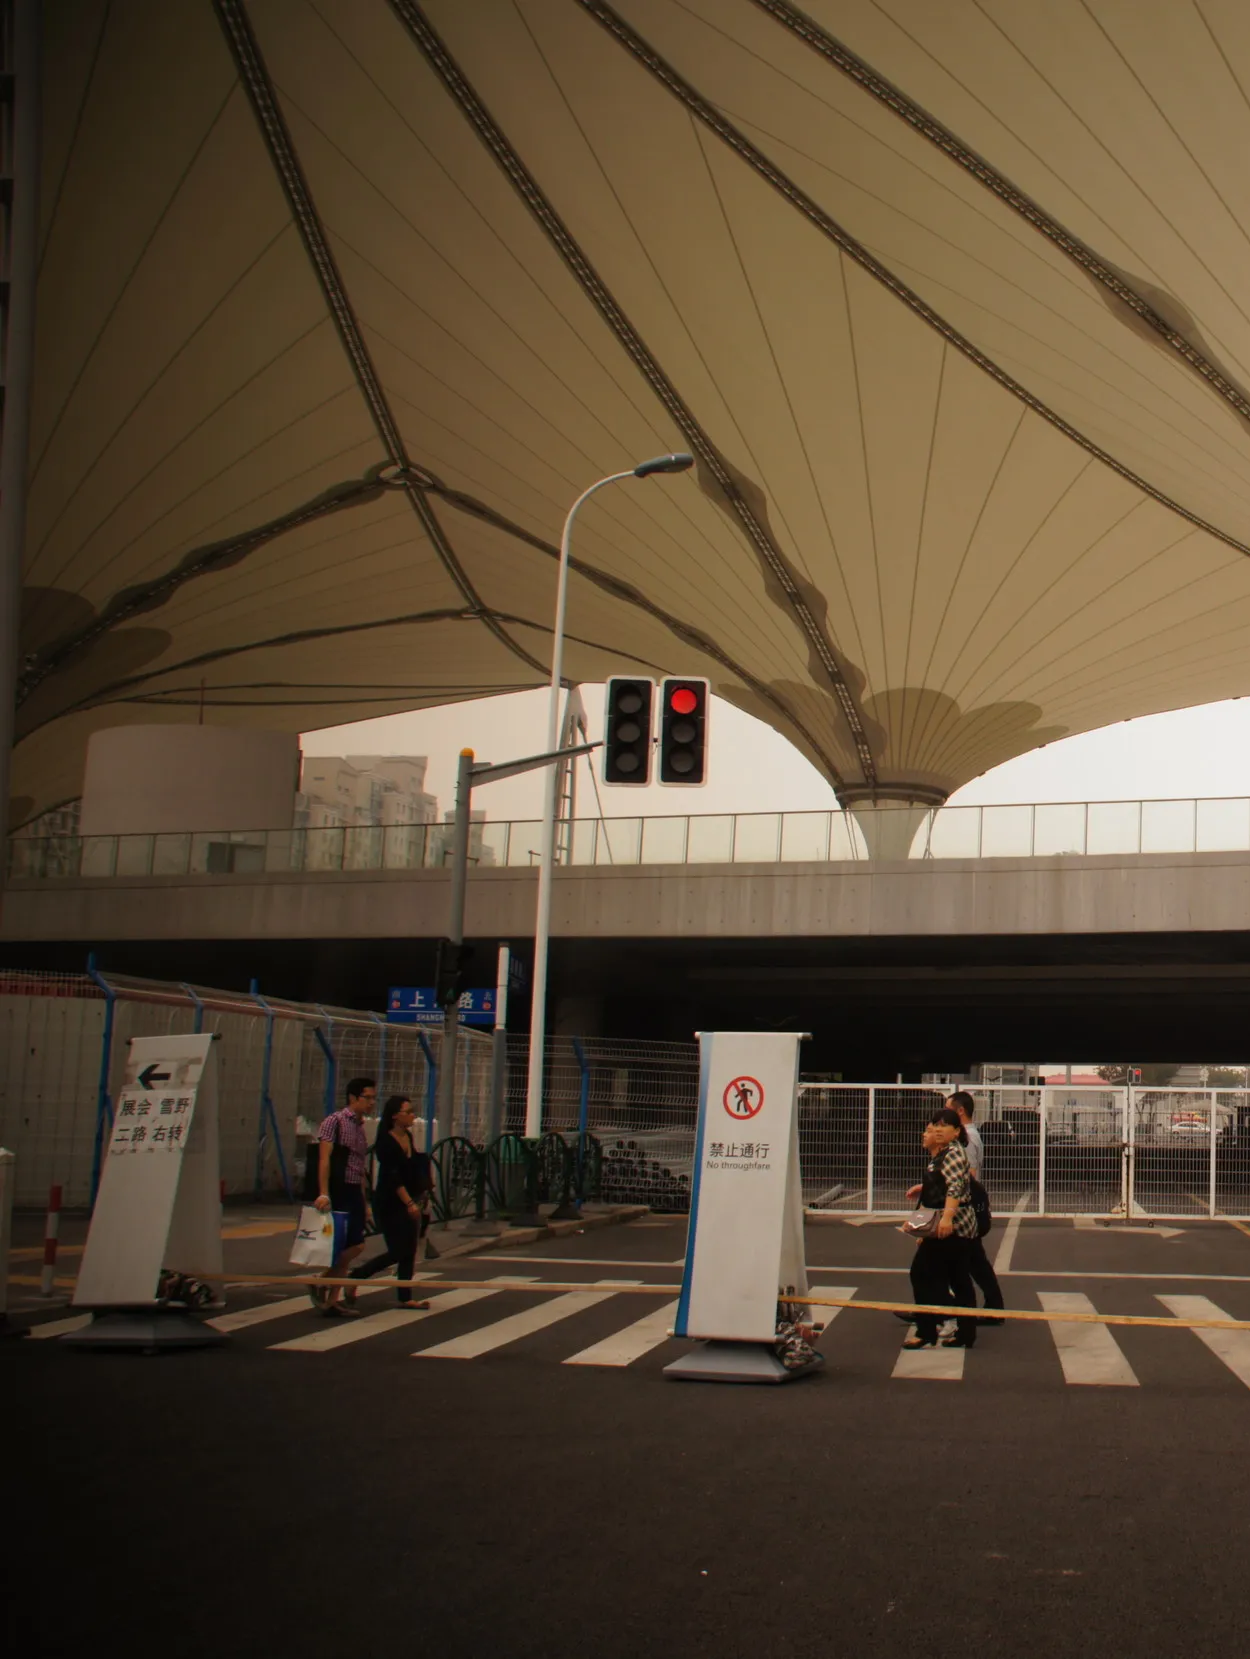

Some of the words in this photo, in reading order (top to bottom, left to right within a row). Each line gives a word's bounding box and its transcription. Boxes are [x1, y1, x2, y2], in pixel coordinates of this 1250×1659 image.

[408, 990, 475, 1009] 上路
[120, 1099, 152, 1116] 展会
[160, 1097, 190, 1115] 雪野
[115, 1126, 147, 1142] 二路
[152, 1123, 183, 1142] 右转
[709, 1142, 770, 1159] 禁止通行
[706, 1161, 719, 1169] No
